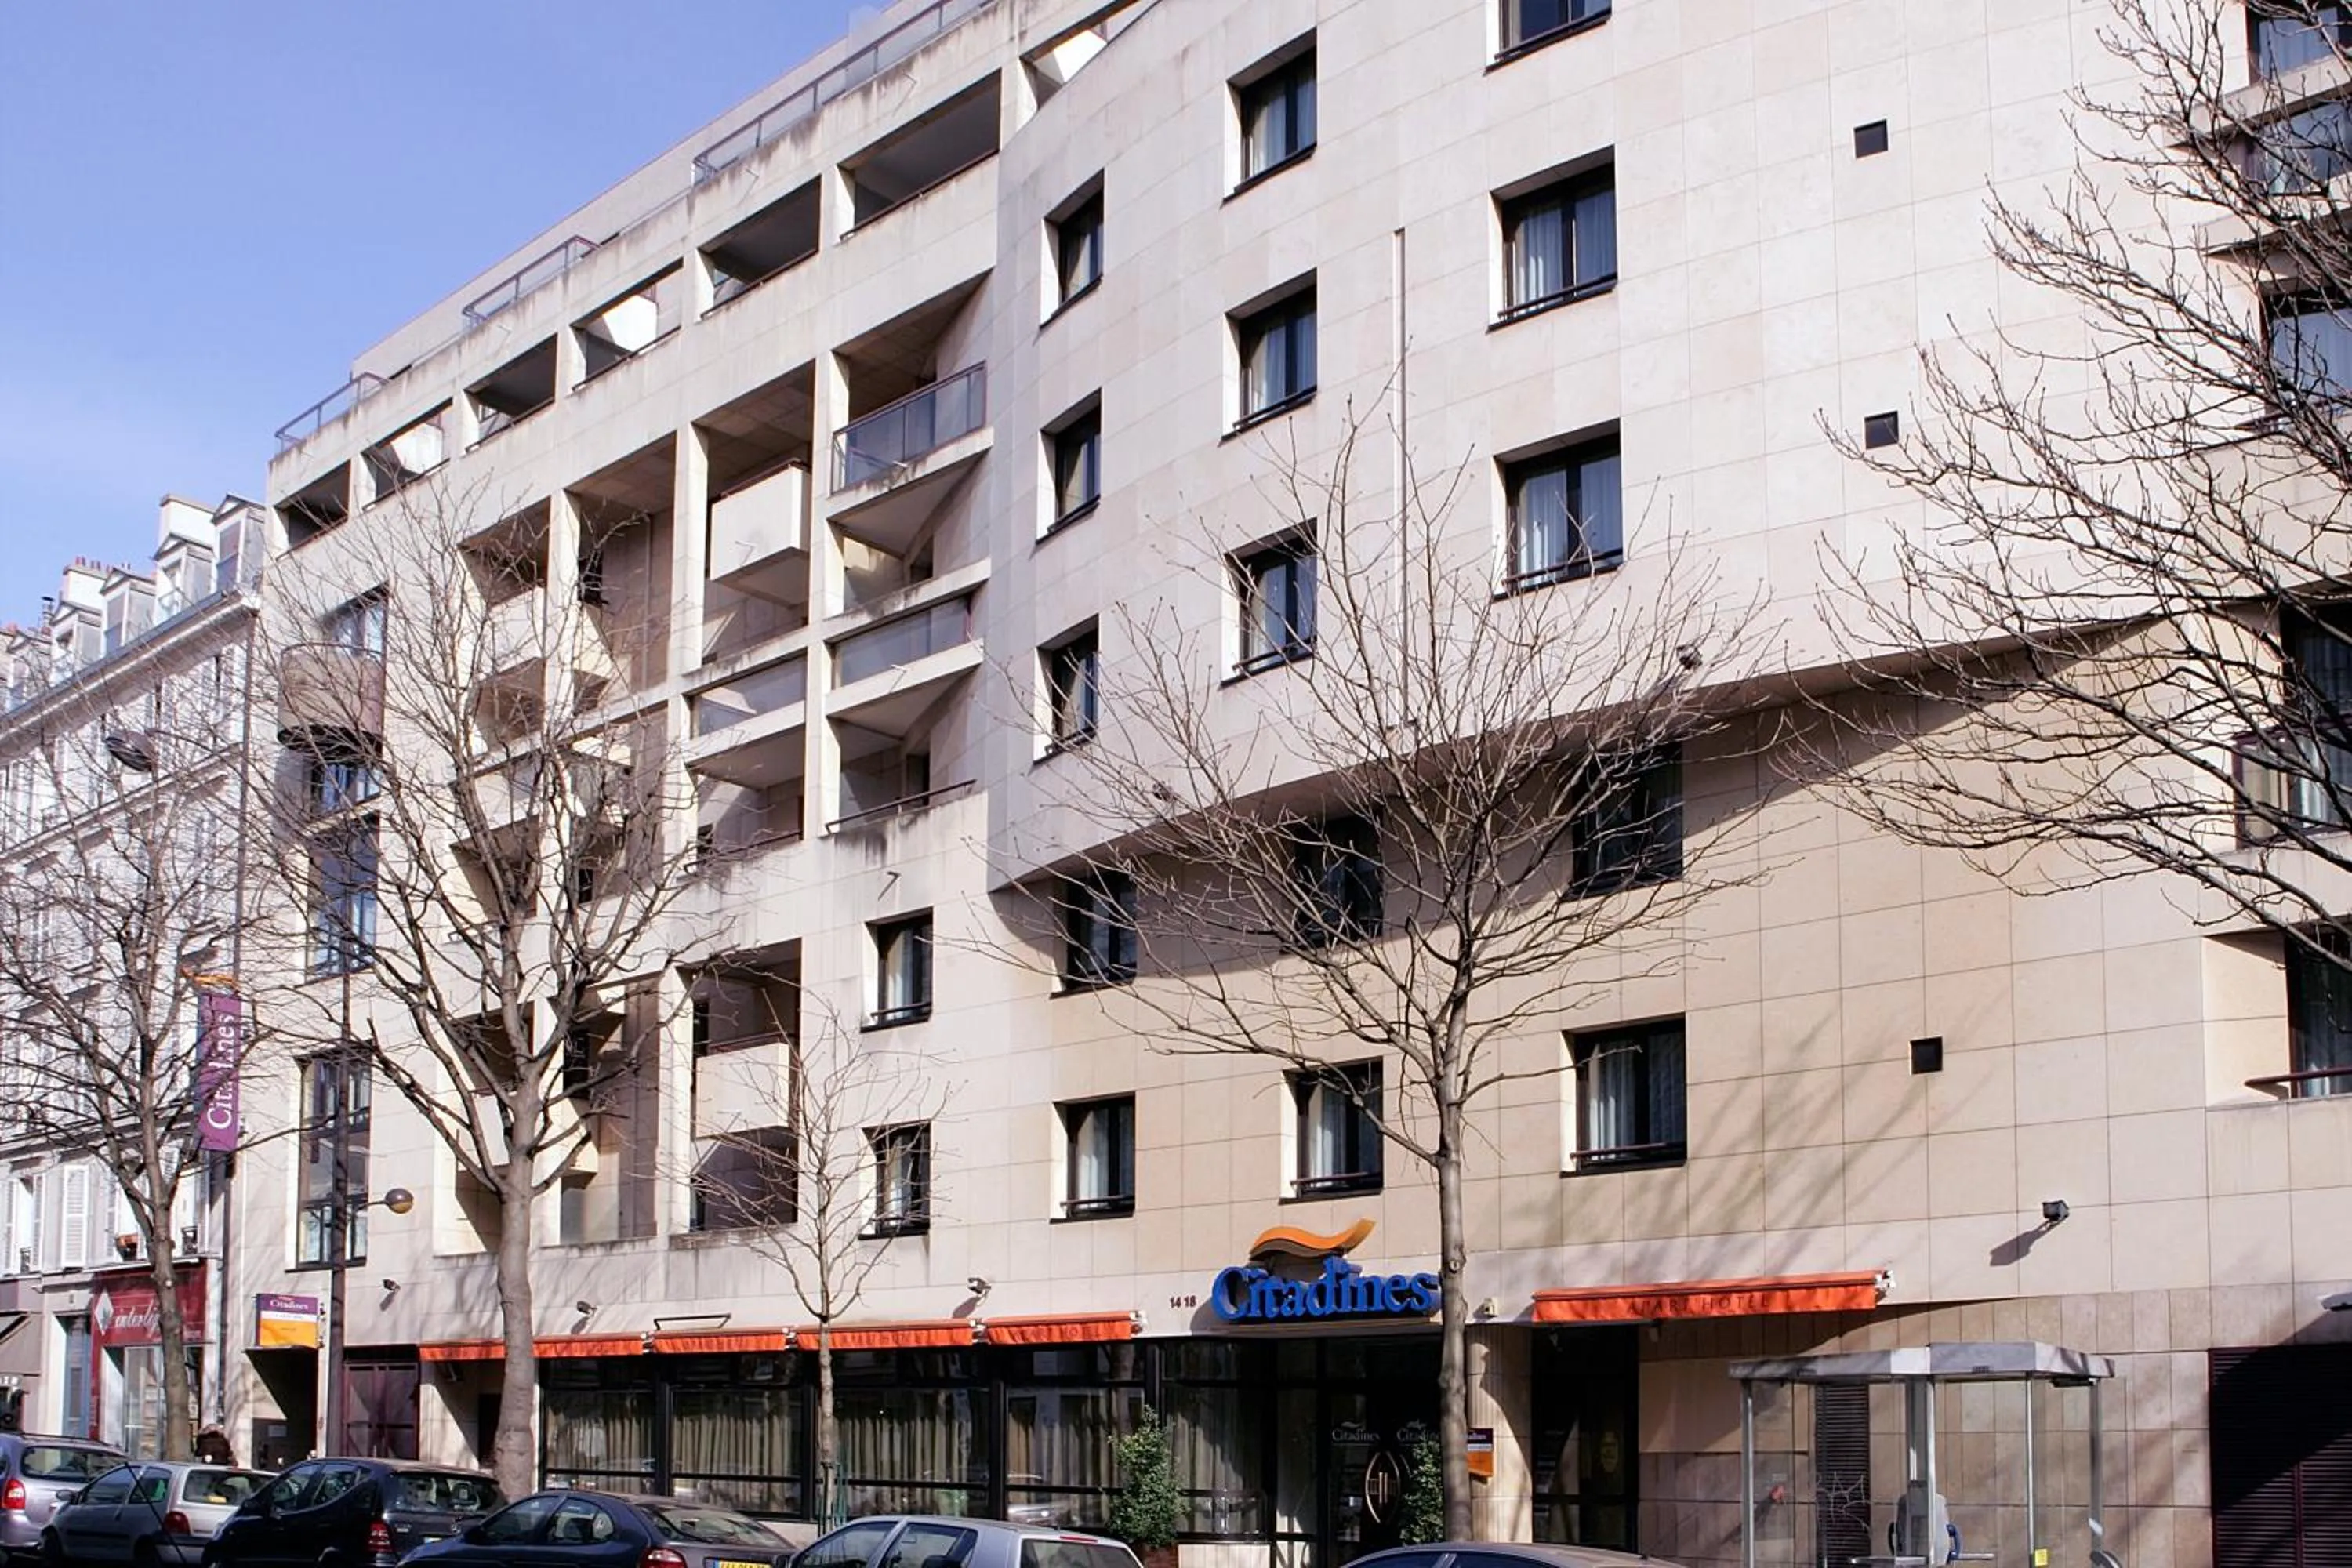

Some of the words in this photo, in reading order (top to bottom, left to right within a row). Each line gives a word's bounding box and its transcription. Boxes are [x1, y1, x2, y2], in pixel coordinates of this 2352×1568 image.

[207, 1014, 235, 1129] Citines
[1213, 1254, 1439, 1321] Citadines
[1170, 1296, 1181, 1308] 14
[1184, 1295, 1196, 1308] 18
[1332, 1428, 1381, 1442] Citadines
[1396, 1428, 1439, 1442] Citadin
